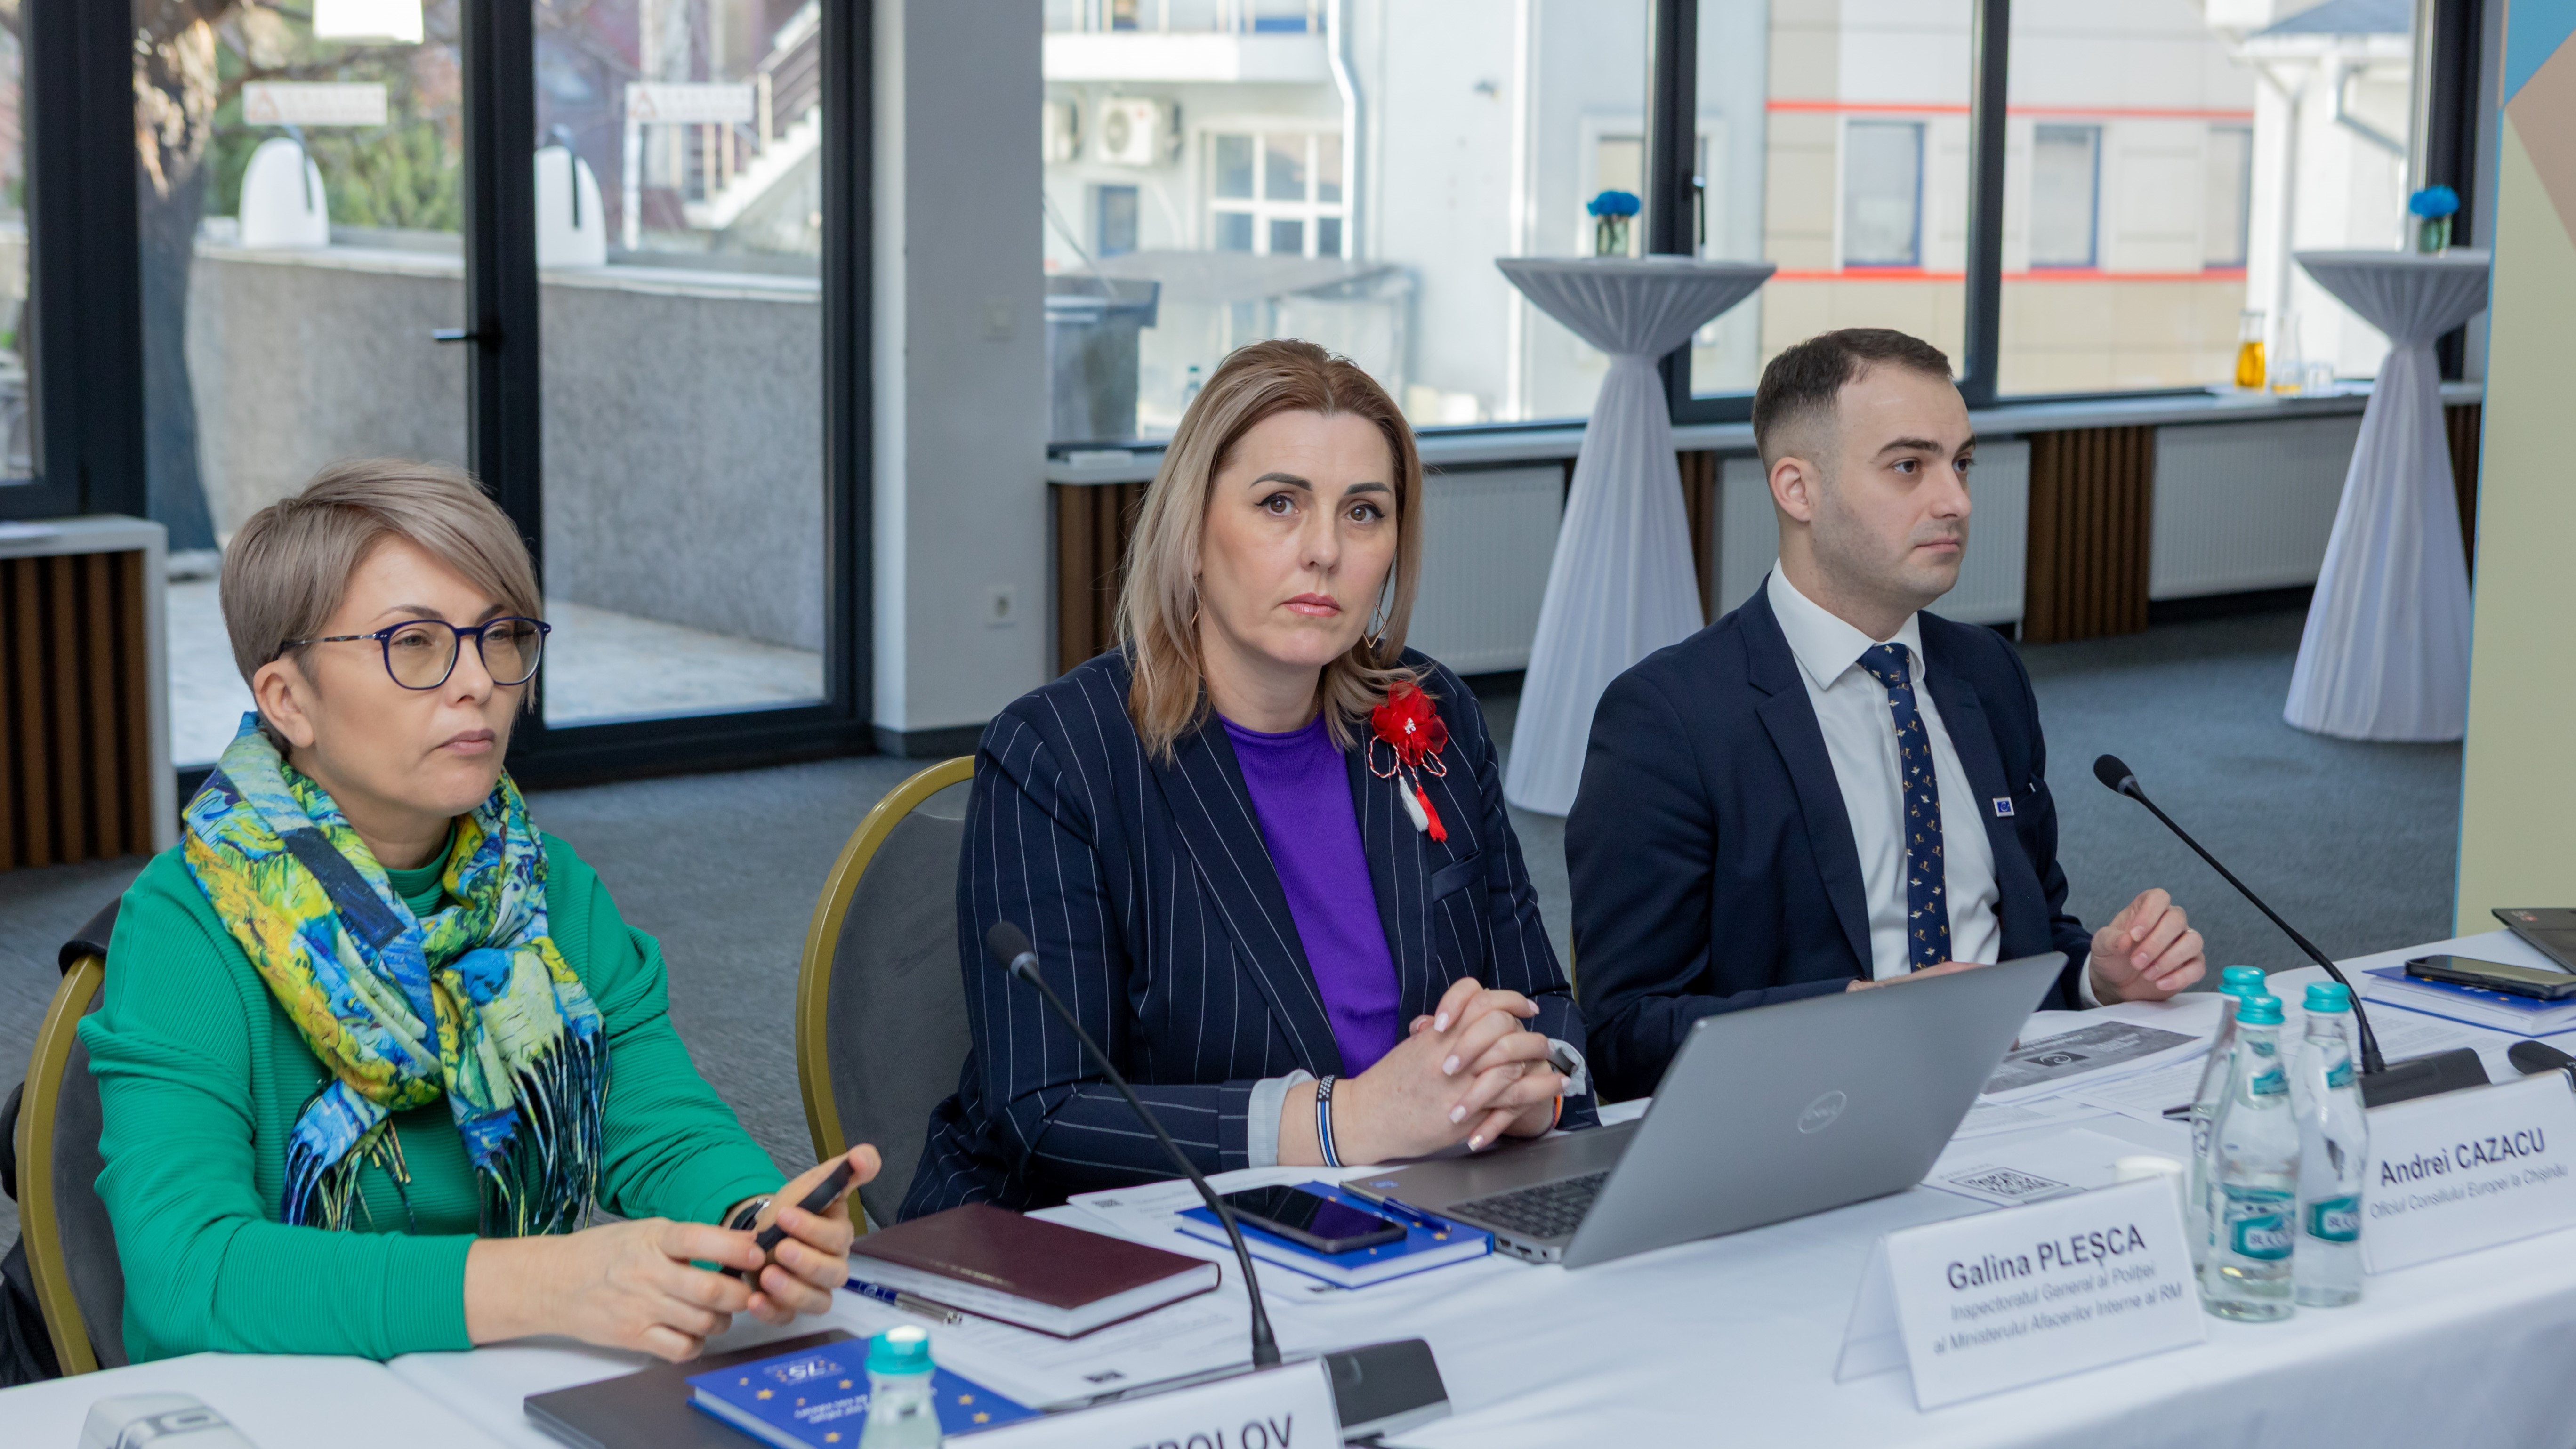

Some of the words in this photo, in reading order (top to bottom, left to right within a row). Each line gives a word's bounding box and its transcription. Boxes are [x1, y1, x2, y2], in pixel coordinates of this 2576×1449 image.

[2381, 1147, 2451, 1186] Andrei
[2455, 1127, 2545, 1168] CAZACU
[1947, 1253, 2032, 1290] Galina
[2037, 1224, 2146, 1271] PLEȘCA
[1934, 1336, 1945, 1354] al
[1950, 1317, 2027, 1350] Ministerului
[2096, 1292, 2141, 1317] Interne
[2145, 1288, 2156, 1306] al
[2160, 1280, 2182, 1303] RM
[1951, 1286, 2038, 1323] Inspectoratul
[2042, 1273, 2093, 1301] General
[2097, 1271, 2108, 1289] al
